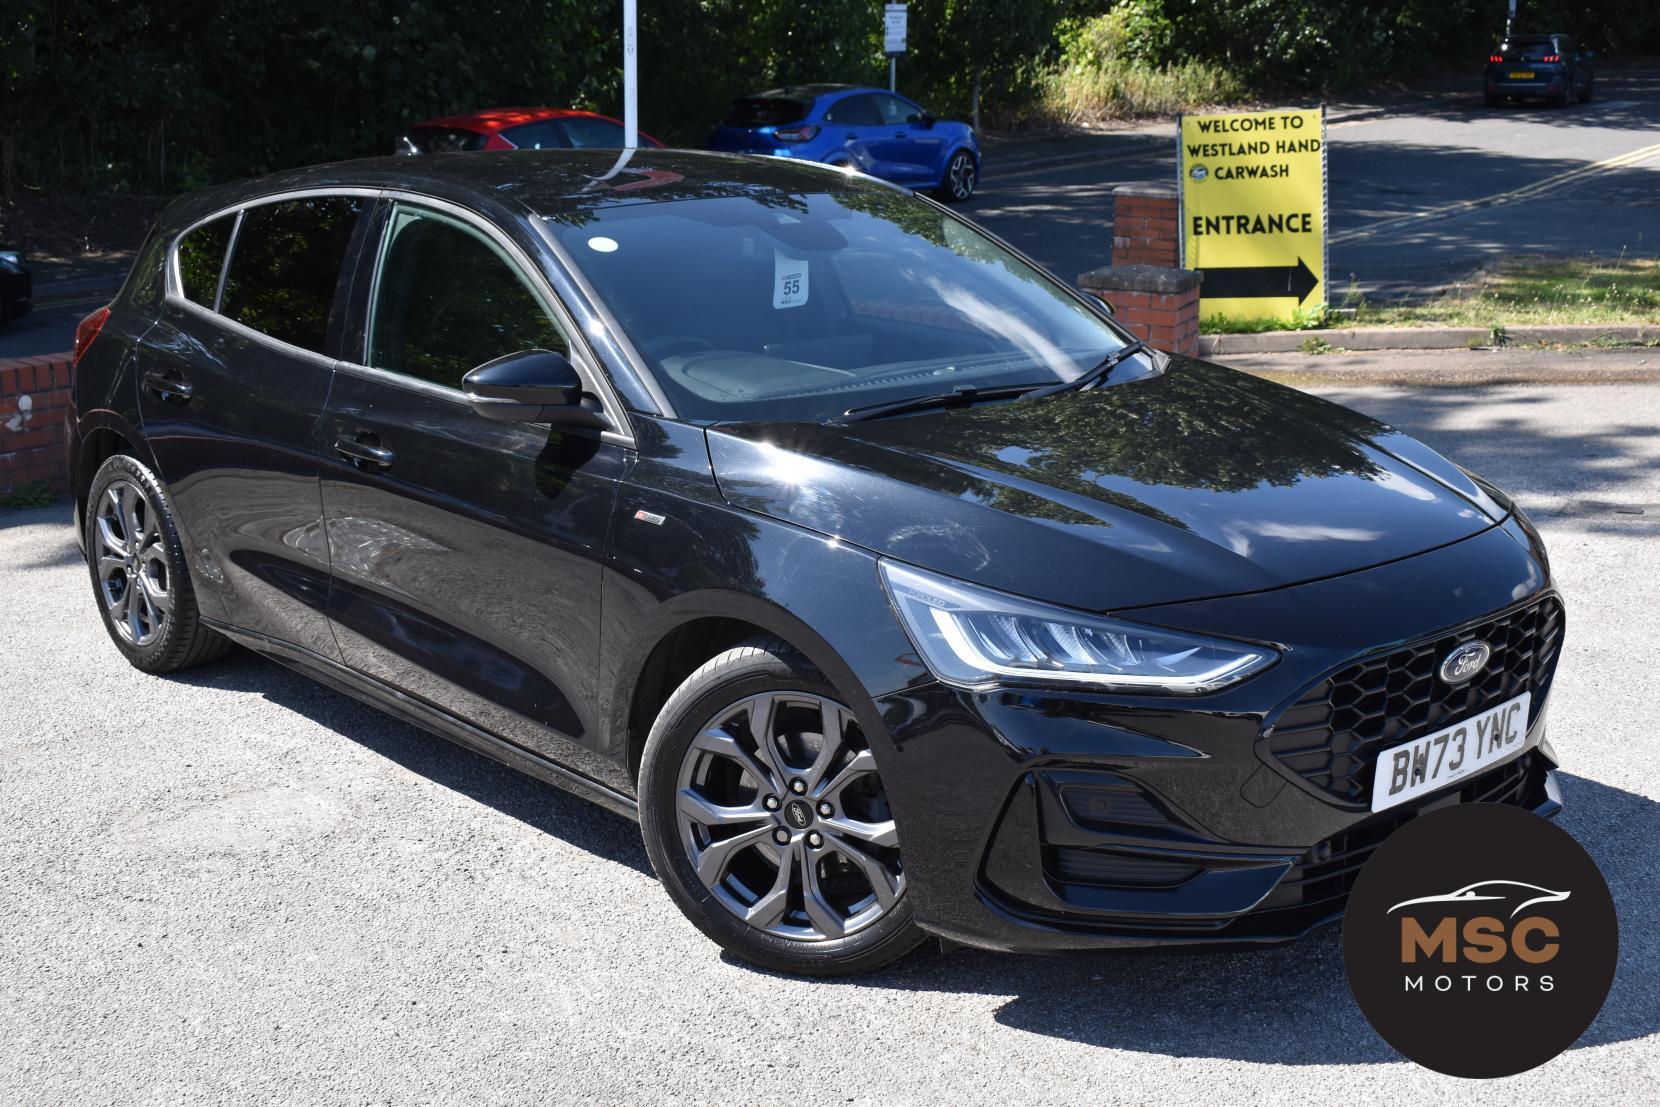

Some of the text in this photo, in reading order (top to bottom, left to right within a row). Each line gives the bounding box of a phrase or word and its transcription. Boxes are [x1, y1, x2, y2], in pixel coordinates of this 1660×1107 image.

[1197, 115, 1304, 133] WELCOME TO
[1187, 138, 1320, 157] WESTLAND HAND
[1214, 164, 1289, 180] CARWASH
[1192, 213, 1312, 236] ENTRANCE
[783, 280, 800, 295] 55
[1454, 652, 1482, 676] Ford
[1388, 702, 1520, 796] BW73 YNC
